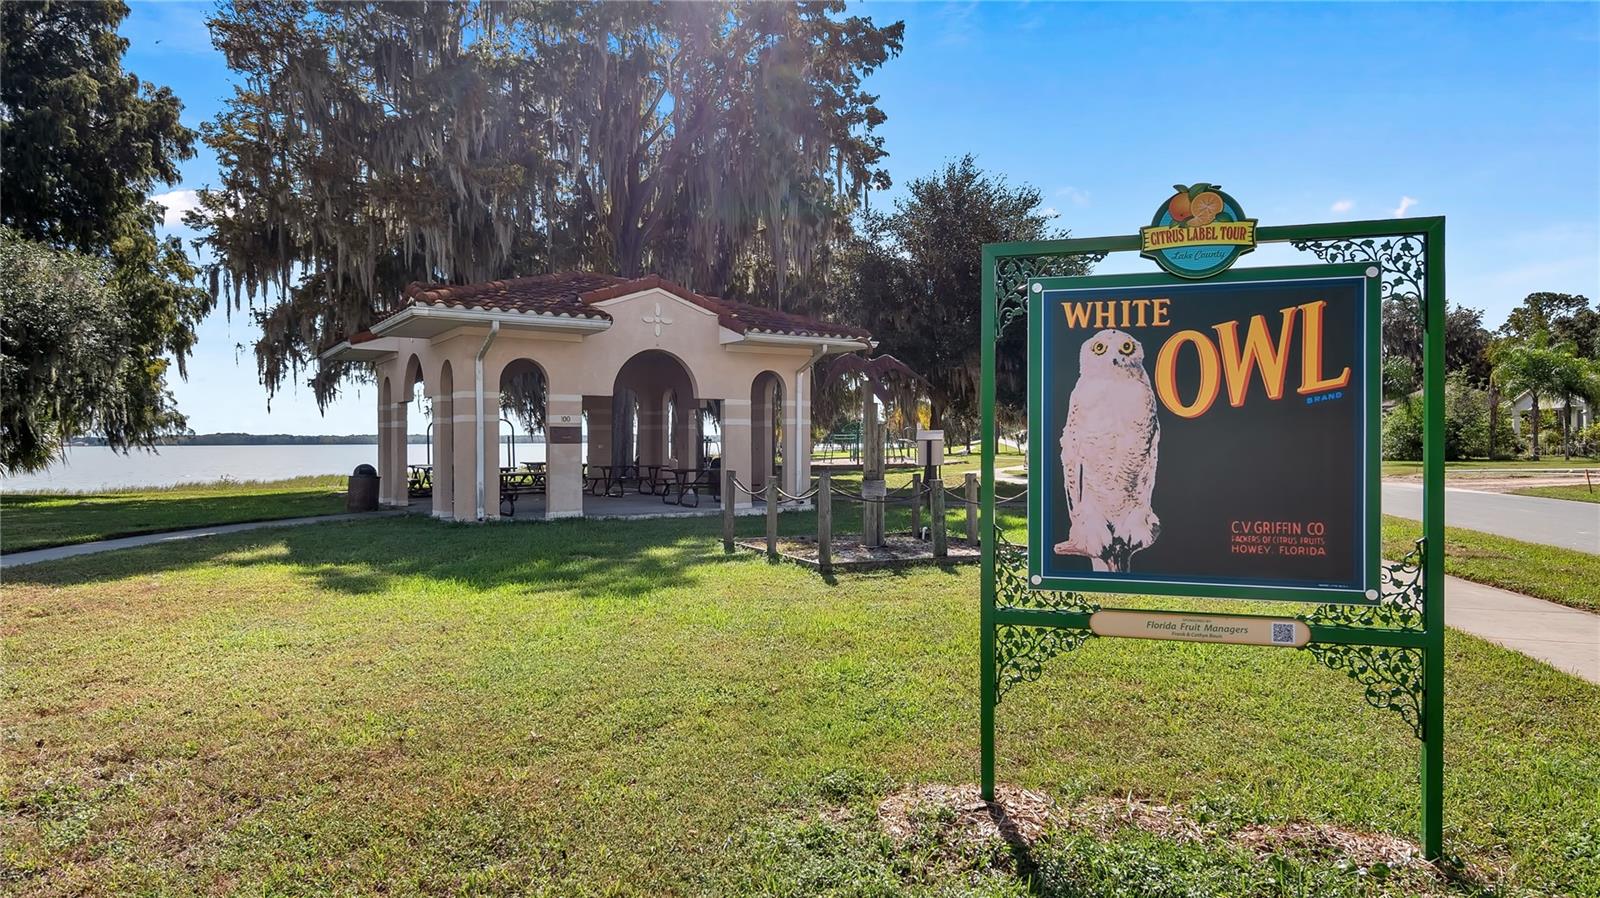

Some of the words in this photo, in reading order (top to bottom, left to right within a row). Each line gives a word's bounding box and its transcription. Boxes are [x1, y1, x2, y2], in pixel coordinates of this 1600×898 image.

[1150, 228, 1185, 246] CITRUS
[1187, 226, 1218, 241] LABEL
[1220, 225, 1247, 241] TOUR
[1171, 251, 1193, 260] Lake
[1194, 250, 1227, 261] County
[1061, 298, 1171, 329] WHITE
[1155, 300, 1350, 418] OWL
[1306, 391, 1343, 404] BRAND
[1254, 521, 1301, 535] GRIFFIN
[1262, 535, 1271, 544] OF
[1272, 536, 1298, 545] CITRUS
[1300, 537, 1325, 545] FRUITS
[1279, 546, 1326, 556] FLORIDA
[1146, 620, 1176, 630] Florida
[1180, 622, 1200, 631] Fruit
[1204, 624, 1249, 635] Managers
